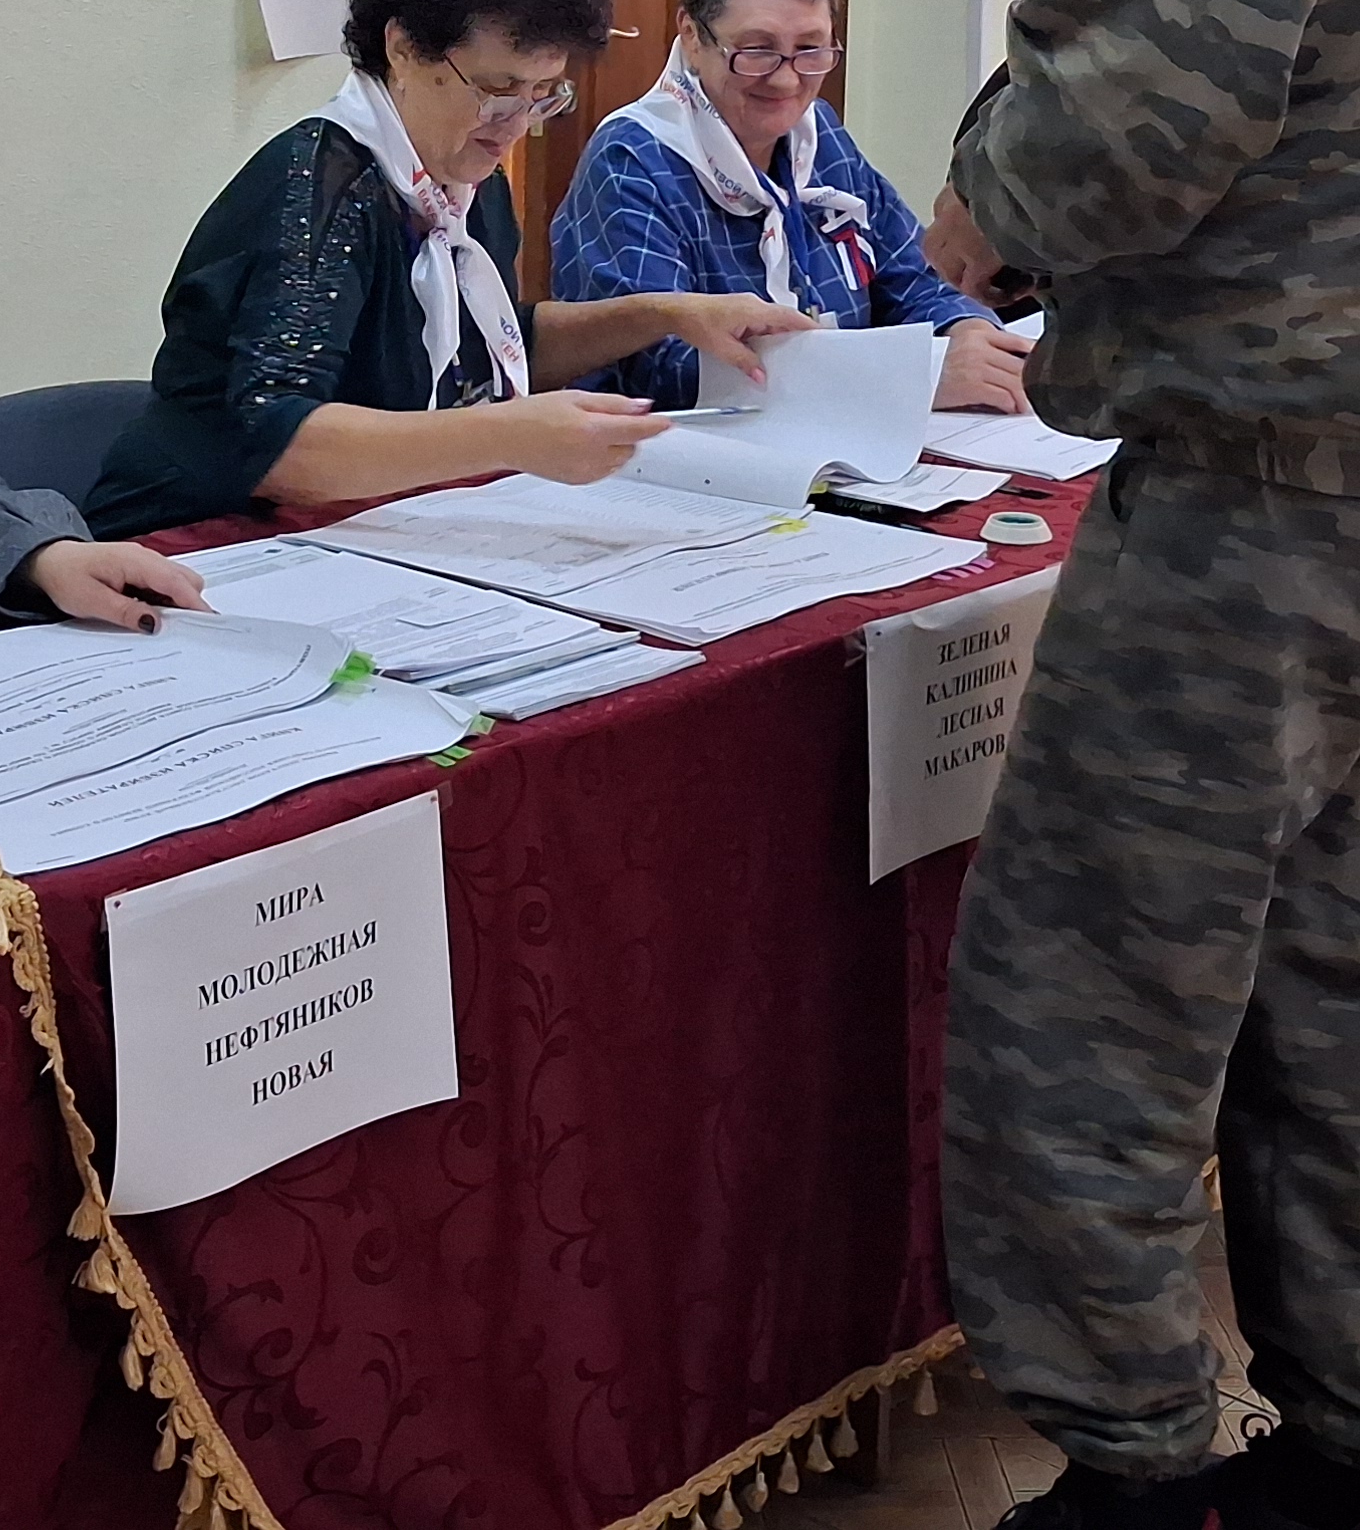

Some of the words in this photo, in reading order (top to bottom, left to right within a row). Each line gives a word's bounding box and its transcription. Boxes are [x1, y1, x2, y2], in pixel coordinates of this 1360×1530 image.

[938, 624, 1010, 666] ЗЕЛЕНАЯ
[926, 657, 1017, 706] КАЛИНИНА
[936, 697, 1004, 740] ЛЕСНАЯ
[254, 882, 326, 927] МИРА
[198, 920, 379, 1010] МОЛОДЕЖНАЯ
[204, 977, 375, 1068] НЕФТЯНИКОВ
[252, 1049, 335, 1106] НОВАЯ
